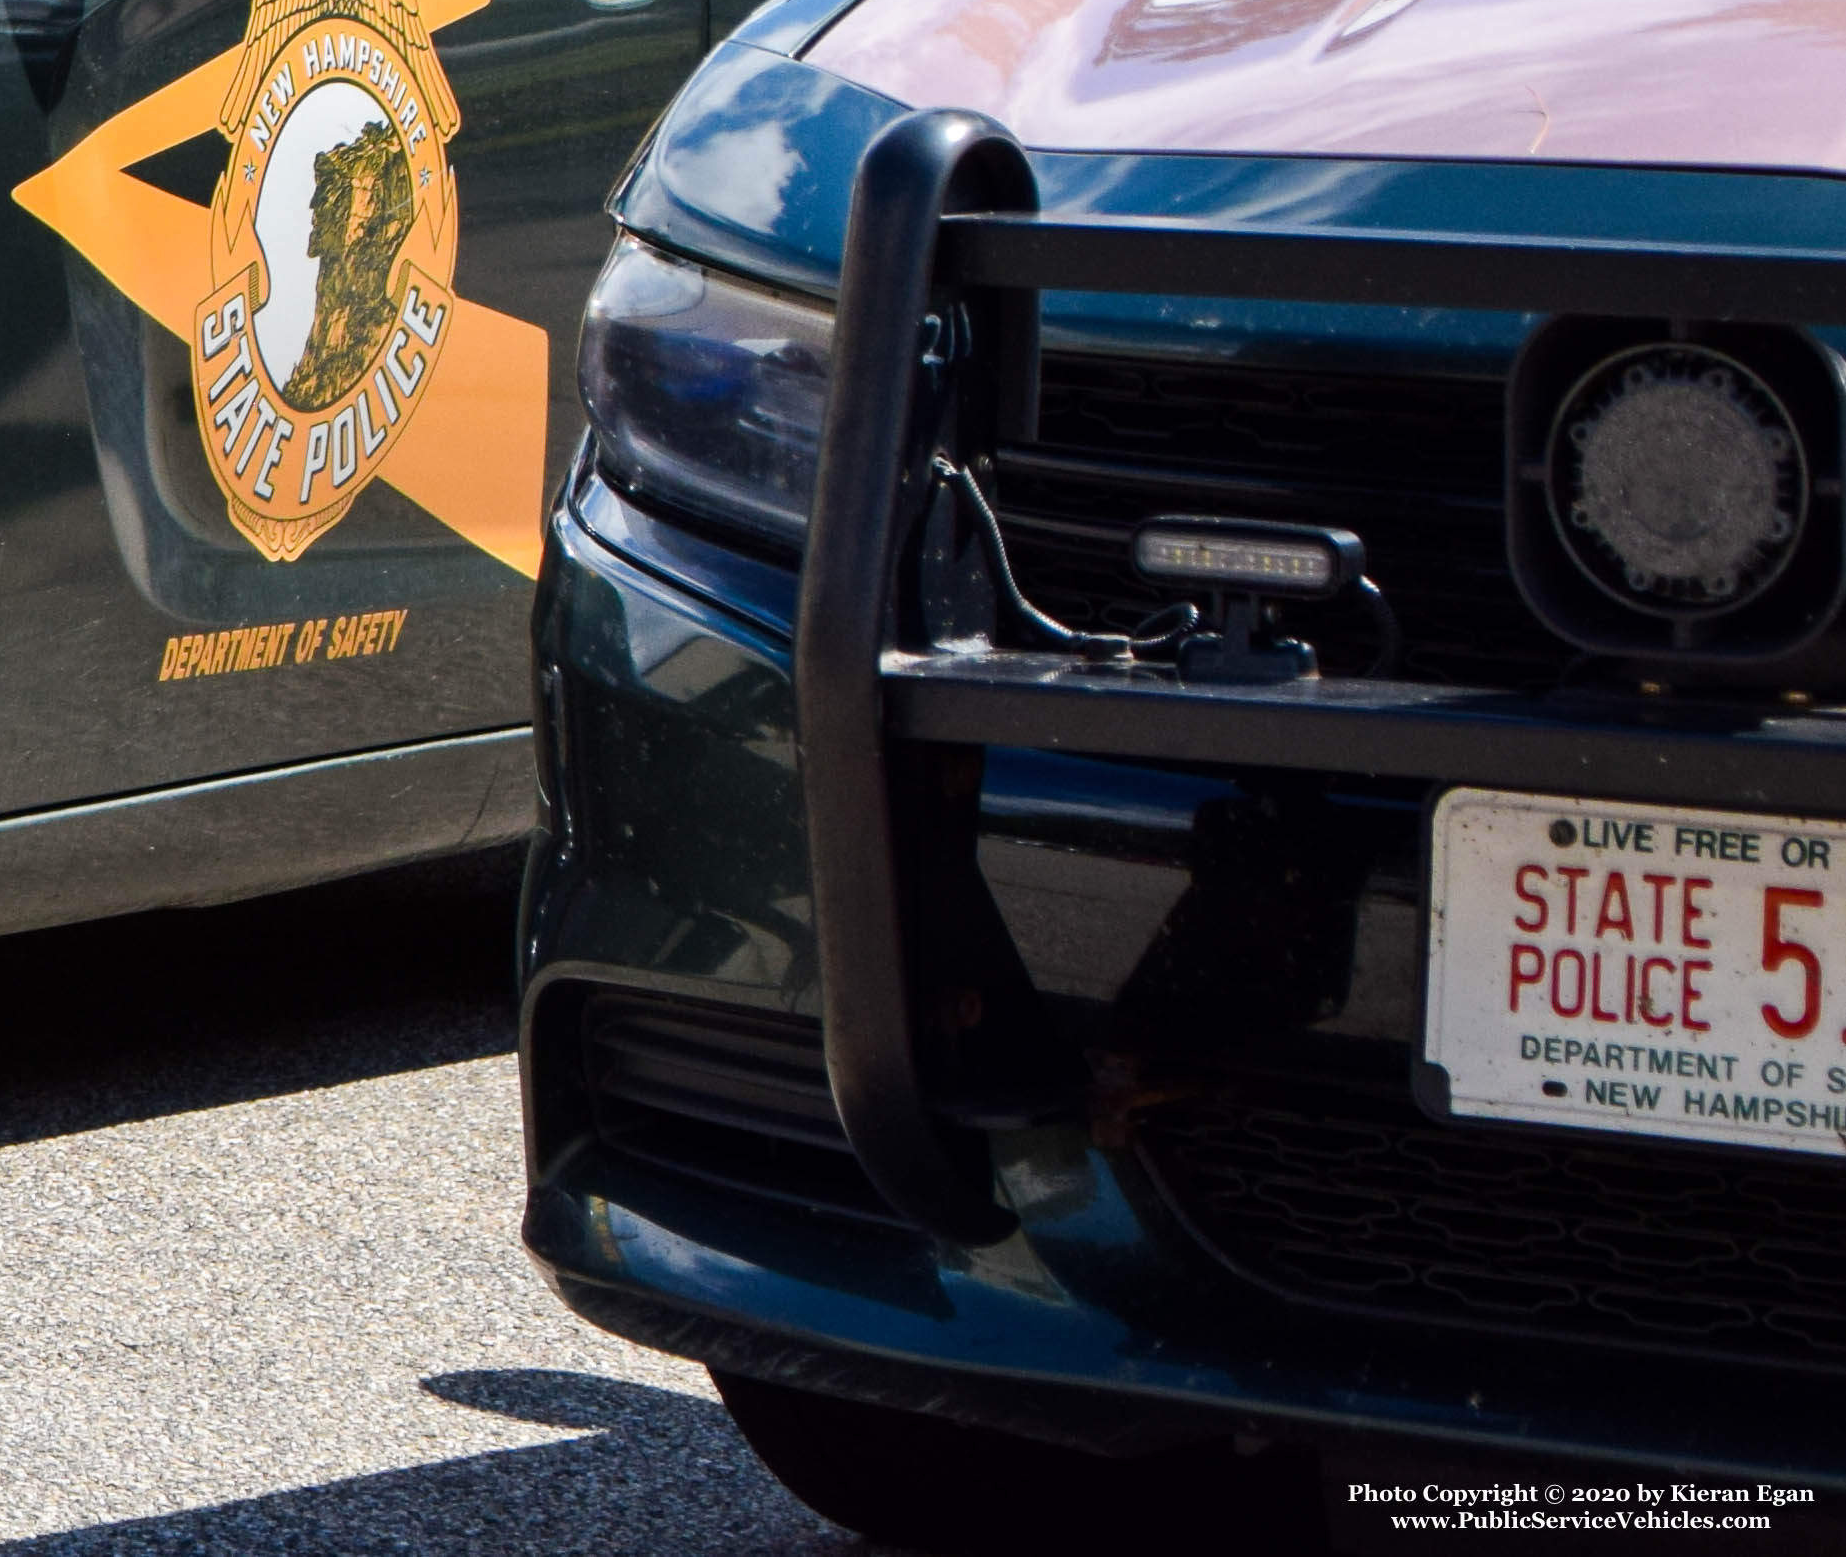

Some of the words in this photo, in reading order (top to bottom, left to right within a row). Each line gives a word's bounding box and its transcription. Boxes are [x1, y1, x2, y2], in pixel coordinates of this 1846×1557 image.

[250, 62, 296, 153] NEW
[302, 33, 427, 156] HAMPSHIRE
[202, 292, 295, 501] STATE
[299, 284, 447, 505] POLICE
[159, 622, 297, 682] DEPARTMENT
[295, 618, 328, 664] OF
[327, 608, 409, 660] SAFETY
[1583, 818, 1654, 854] LIVE
[1675, 827, 1761, 863] FREE
[1781, 836, 1830, 870] OR
[1515, 863, 1713, 950] STATE
[1509, 943, 1714, 1032] POLICE
[1761, 886, 1846, 1047] 5
[1521, 1034, 1740, 1083] DEPARTMENT
[1761, 1060, 1805, 1089] OF
[1827, 1066, 1846, 1094] S
[1585, 1079, 1662, 1111] NEW
[1684, 1089, 1846, 1134] HAMPSHI
